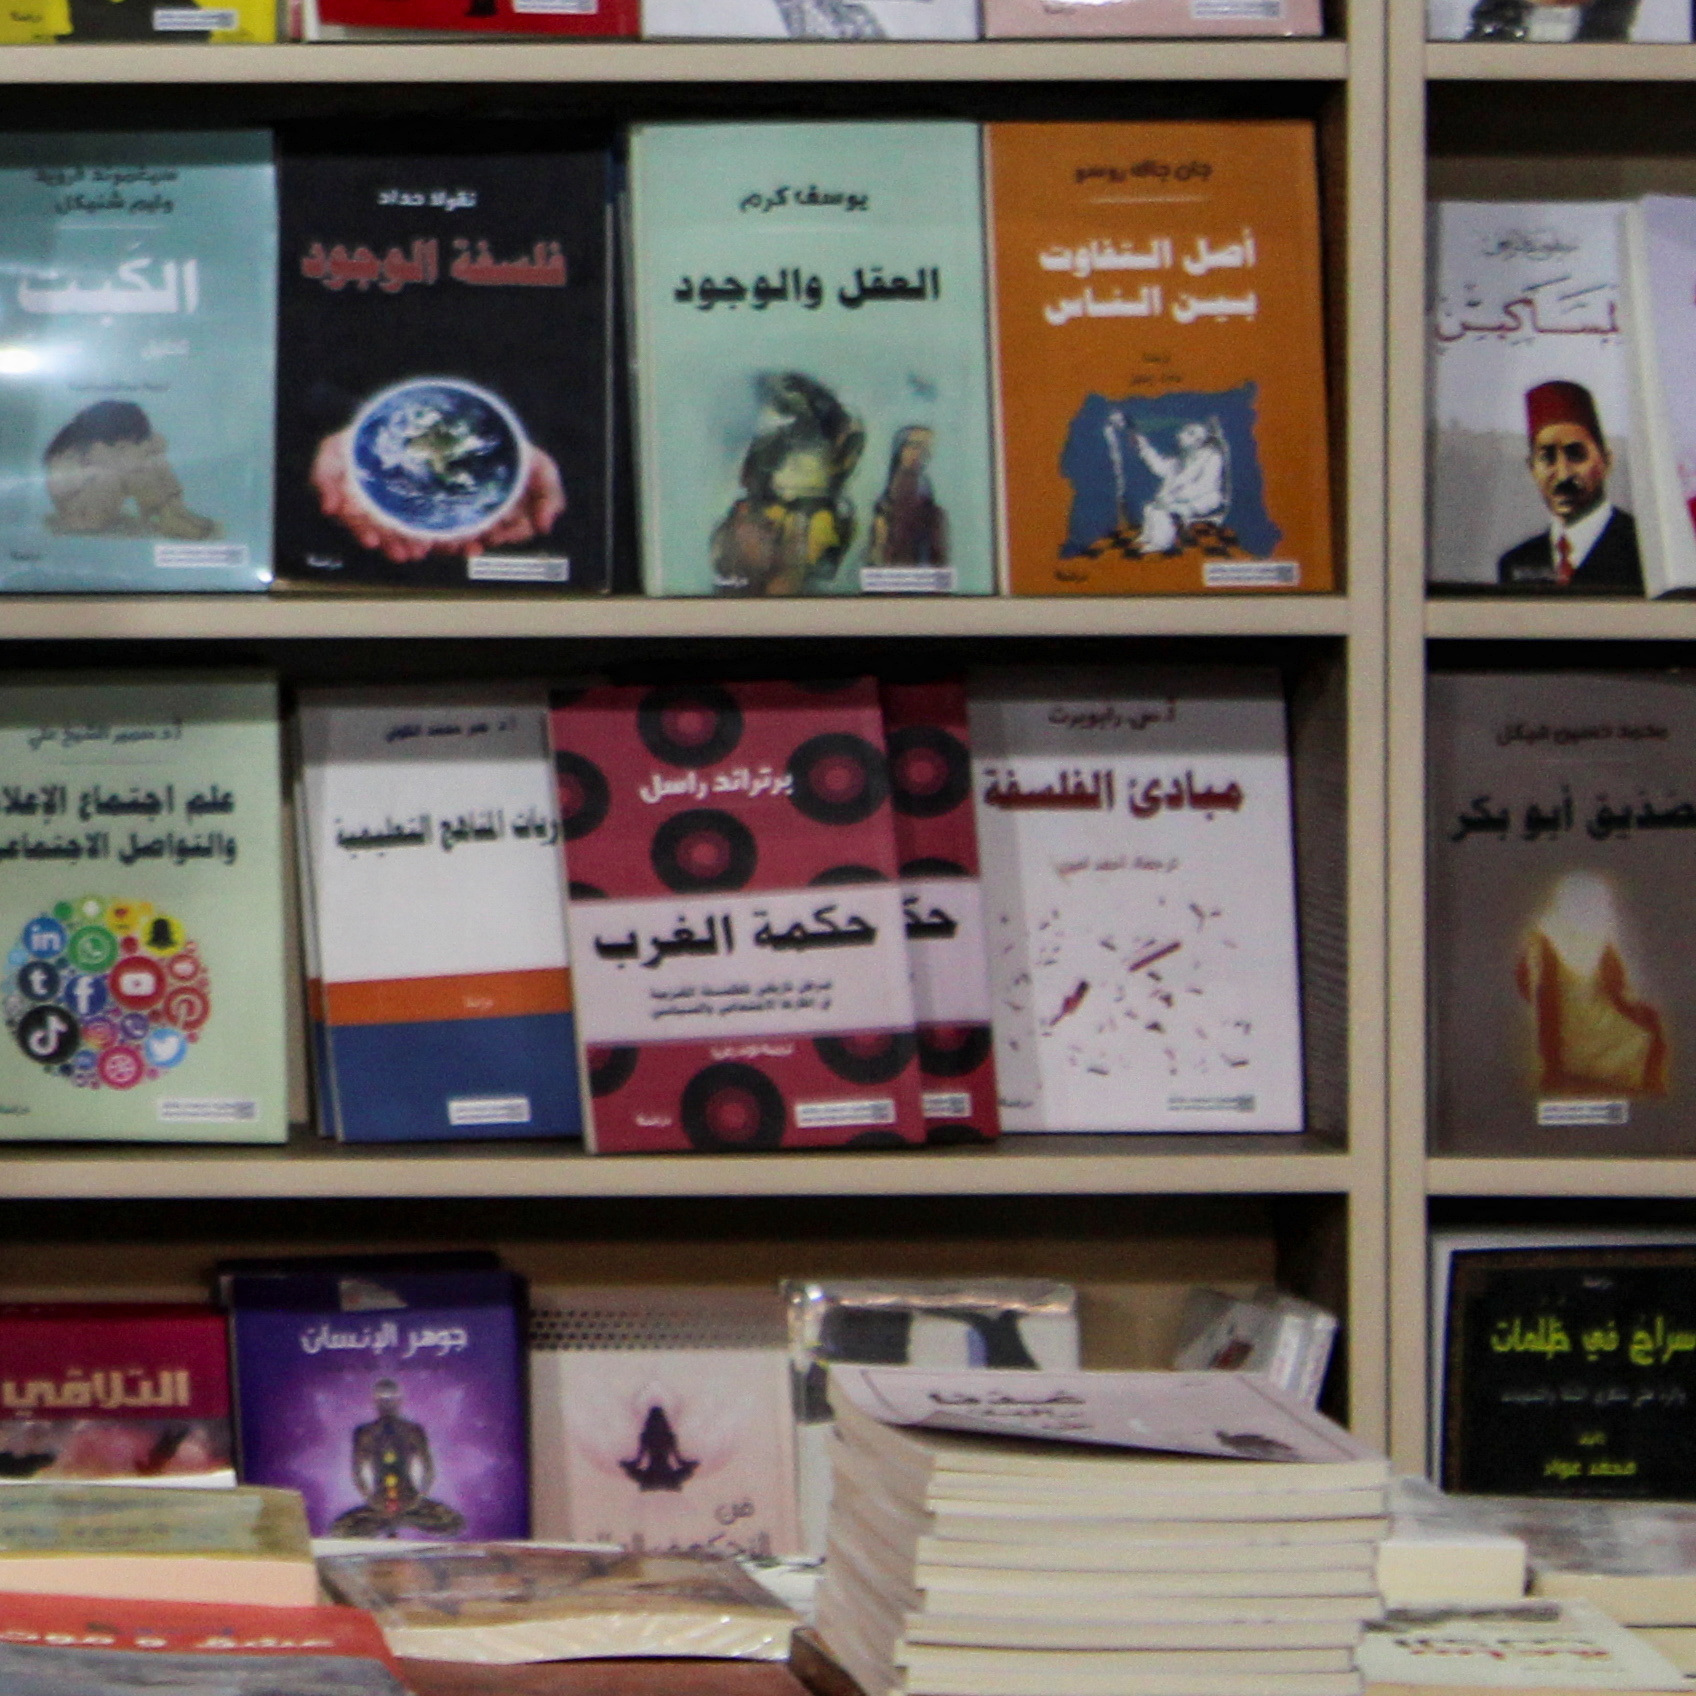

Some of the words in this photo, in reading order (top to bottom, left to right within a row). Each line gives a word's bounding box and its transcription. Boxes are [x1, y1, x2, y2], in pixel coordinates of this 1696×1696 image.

[300, 237, 439, 294] الوجود
[448, 239, 567, 288] فلسفة
[1039, 236, 1171, 279] التفاوت
[1183, 229, 1256, 274] أصل
[673, 269, 823, 314] والوجود
[838, 267, 941, 312] العقل
[1044, 285, 1163, 327] الناس
[1173, 290, 1258, 324] بين
[77, 786, 174, 822] اجتماع
[184, 786, 236, 823] علم
[638, 770, 706, 805] راسل
[707, 765, 794, 800] برتراند
[981, 767, 1114, 812] الفلسفة
[1127, 770, 1246, 821] مبادئ
[1451, 791, 1509, 843] بكر
[1523, 785, 1574, 838] أبو
[118, 829, 237, 867] والتواصل
[593, 913, 736, 968] الغرب
[752, 904, 877, 952] حكمة
[1582, 1320, 1620, 1362] في
[2, 1367, 190, 1419] التلاقي
